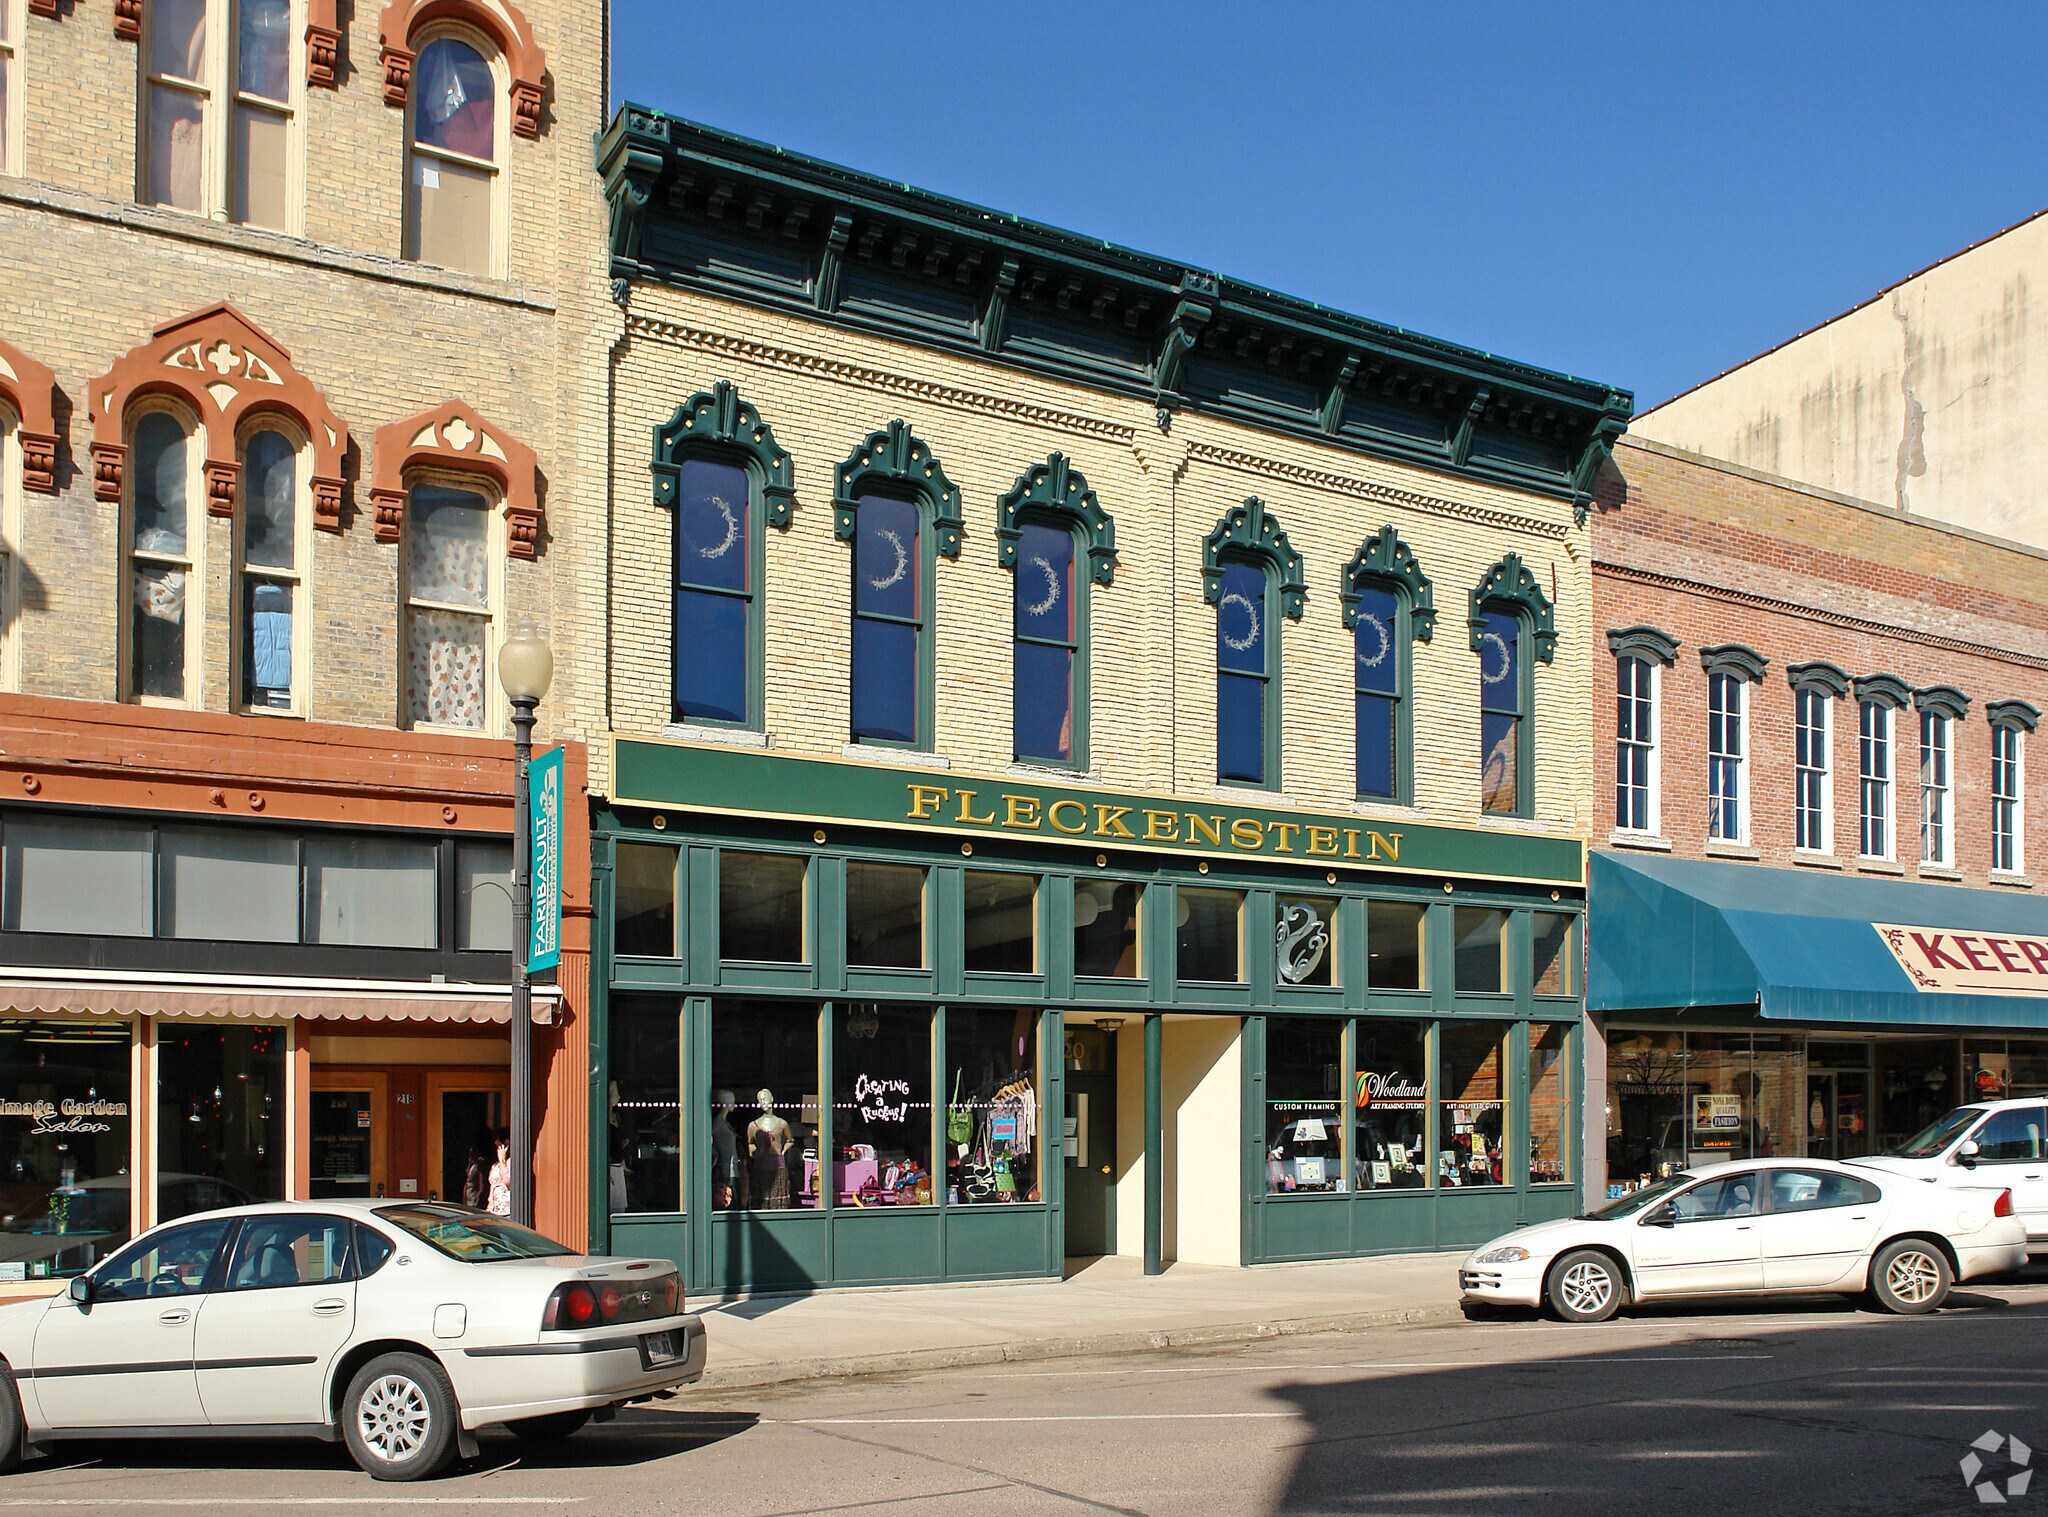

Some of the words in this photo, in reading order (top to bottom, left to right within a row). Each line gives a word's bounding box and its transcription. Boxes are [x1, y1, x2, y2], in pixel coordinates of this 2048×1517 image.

[906, 784, 1404, 863] FLECKENSTEIN
[534, 816, 548, 957] FARIBAULT
[1908, 932, 2048, 975] KEEP
[1368, 1071, 1427, 1098] Woodland
[0, 1099, 54, 1119] Image
[61, 1098, 128, 1116] Garden
[397, 1094, 414, 1104] 218
[875, 1097, 884, 1106] a
[1274, 1103, 1302, 1111] CUSTOM
[1715, 1106, 1737, 1114] QUALITY
[31, 1111, 110, 1134] Salon
